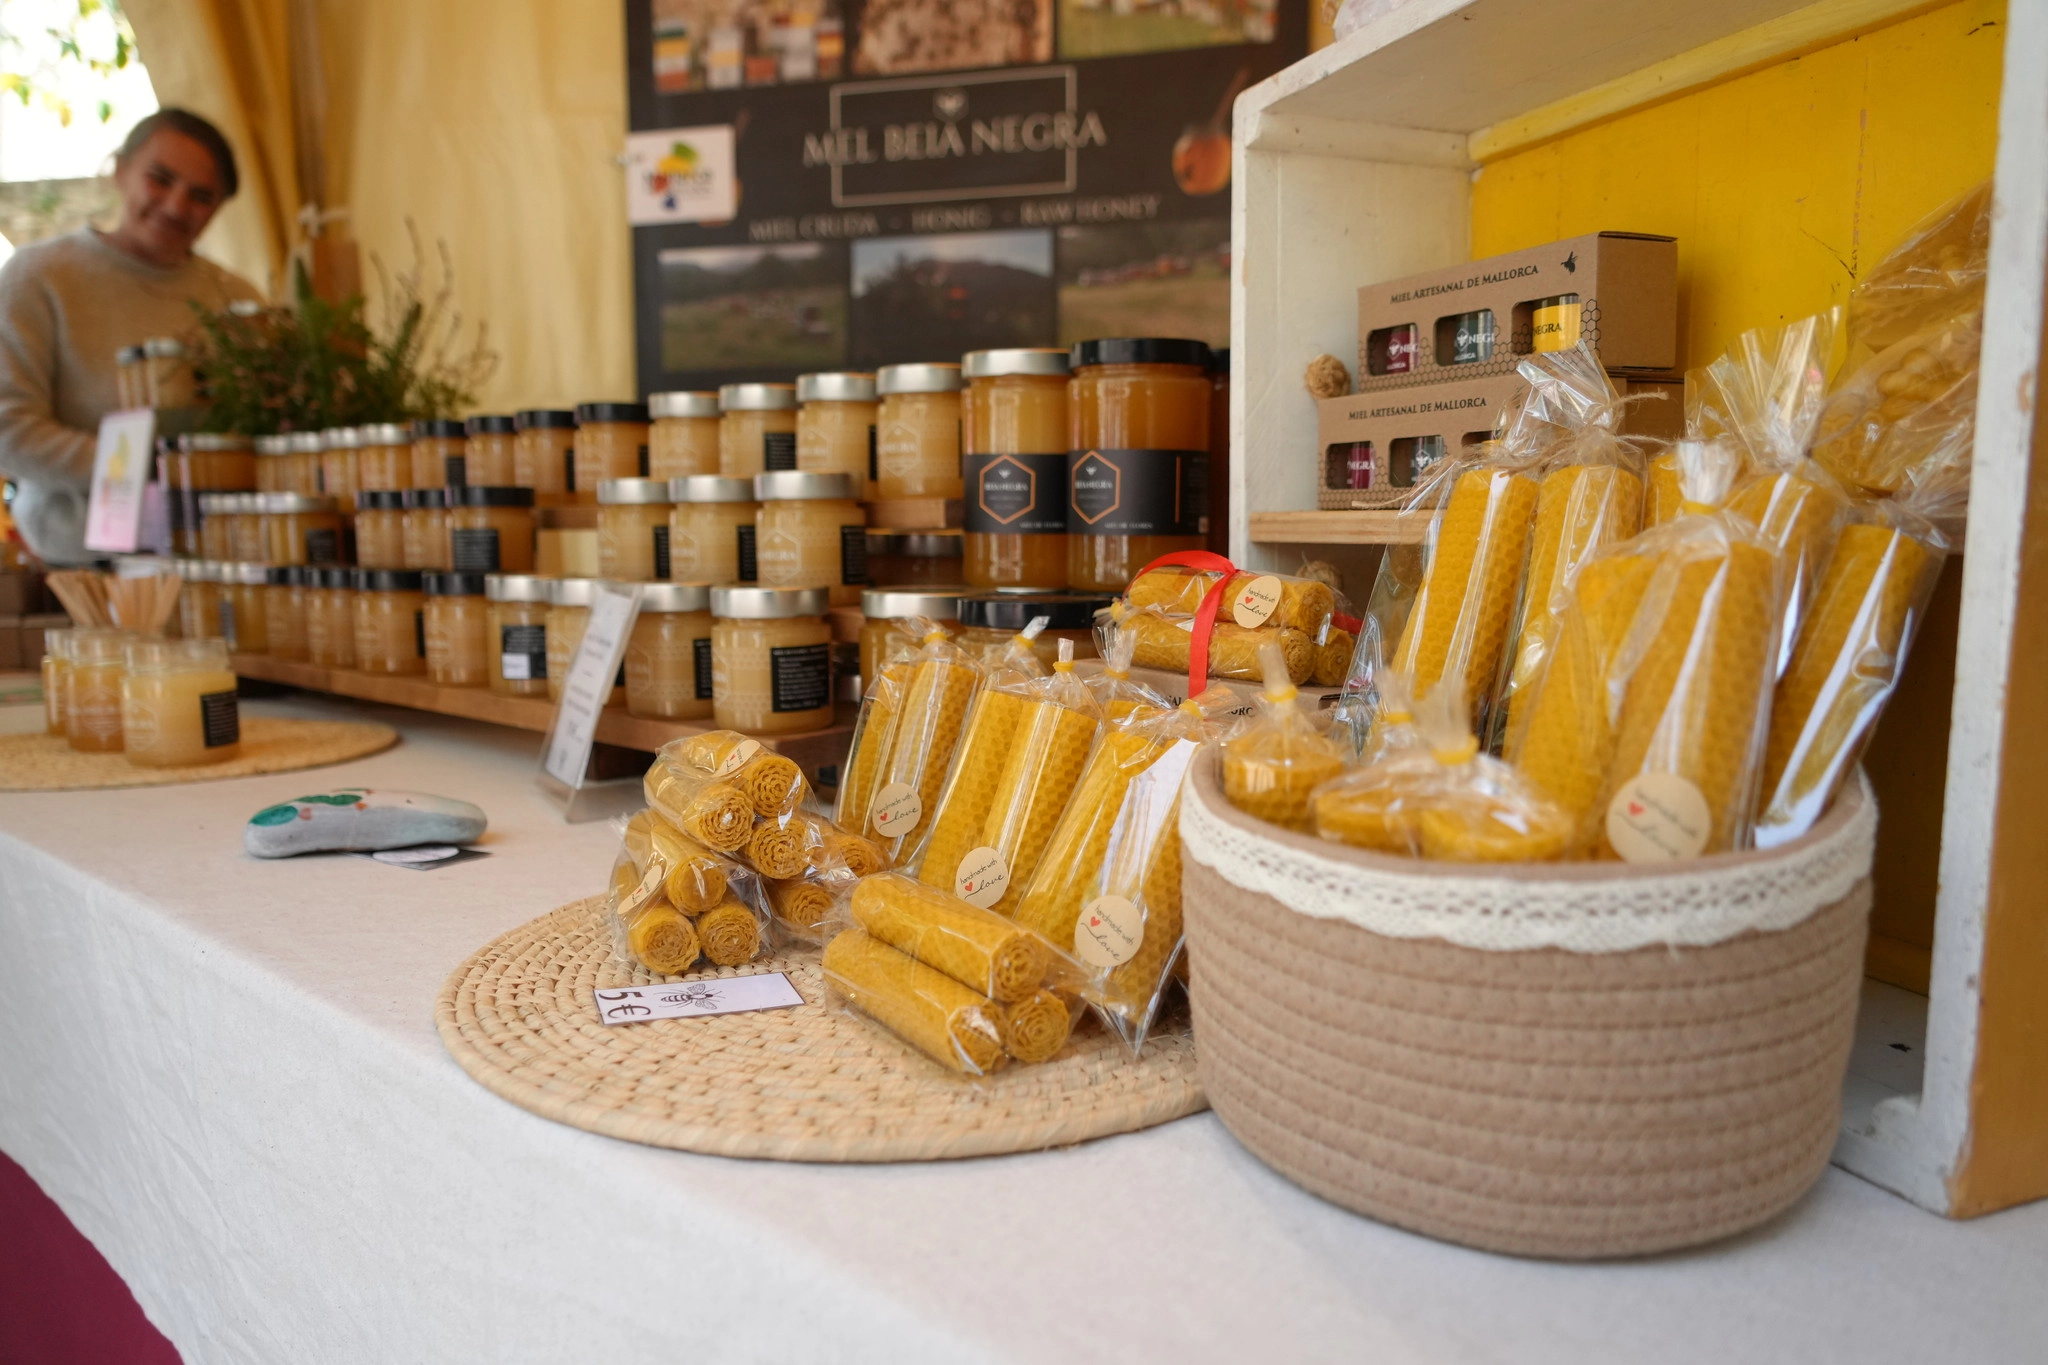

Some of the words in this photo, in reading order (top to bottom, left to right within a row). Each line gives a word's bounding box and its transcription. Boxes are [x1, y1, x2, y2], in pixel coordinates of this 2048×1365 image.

[971, 111, 1108, 155] NEGRA
[1076, 194, 1163, 224] HONEY
[1390, 291, 1412, 304] MIEL
[1412, 281, 1465, 300] ARTESANAL
[1467, 276, 1480, 288] DE
[1481, 265, 1539, 285] MALLORCA
[1348, 410, 1368, 420] MIEL
[1370, 405, 1418, 418] ARTESANAL
[1420, 402, 1432, 413] DE
[1433, 397, 1487, 412] MALLORCA
[960, 865, 987, 884] handmade
[987, 858, 998, 868] with
[1095, 904, 1122, 936] handmade
